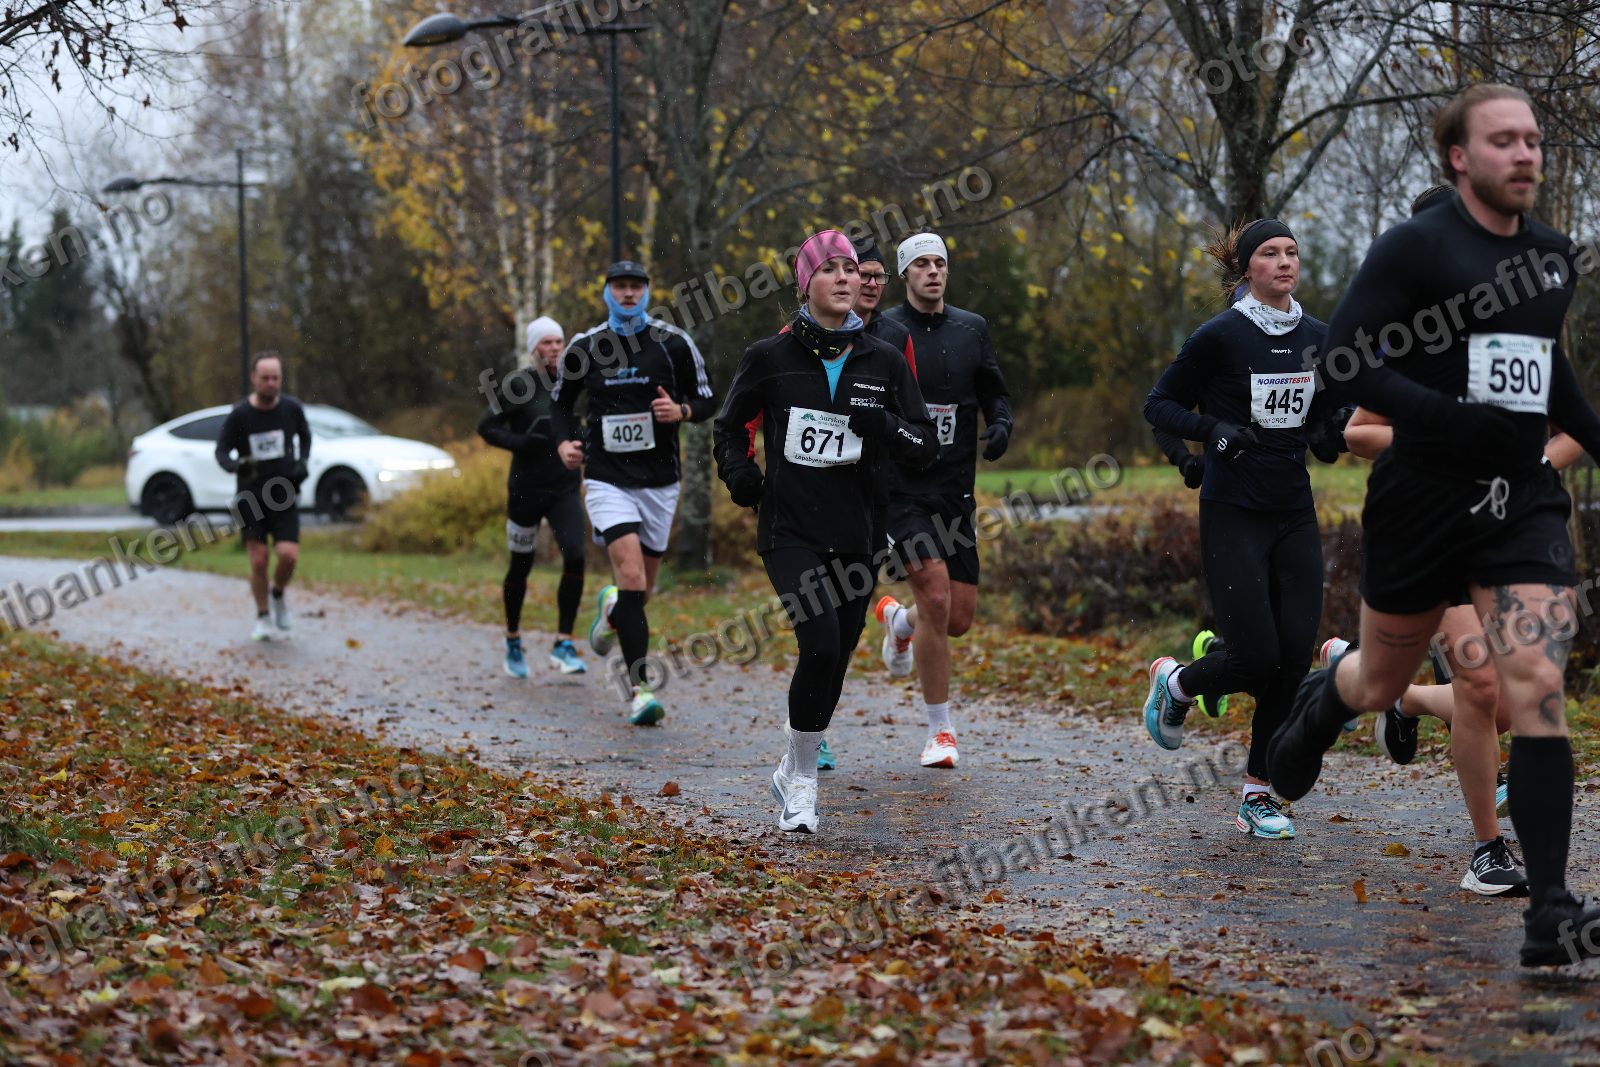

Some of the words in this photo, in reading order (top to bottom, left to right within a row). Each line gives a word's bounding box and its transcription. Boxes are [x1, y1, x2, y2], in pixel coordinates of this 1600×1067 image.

[1257, 376, 1312, 386] NORGESTESTEN
[1488, 357, 1541, 395] 590
[1264, 388, 1304, 415] 445
[612, 424, 643, 443] 402
[800, 426, 845, 458] 671
